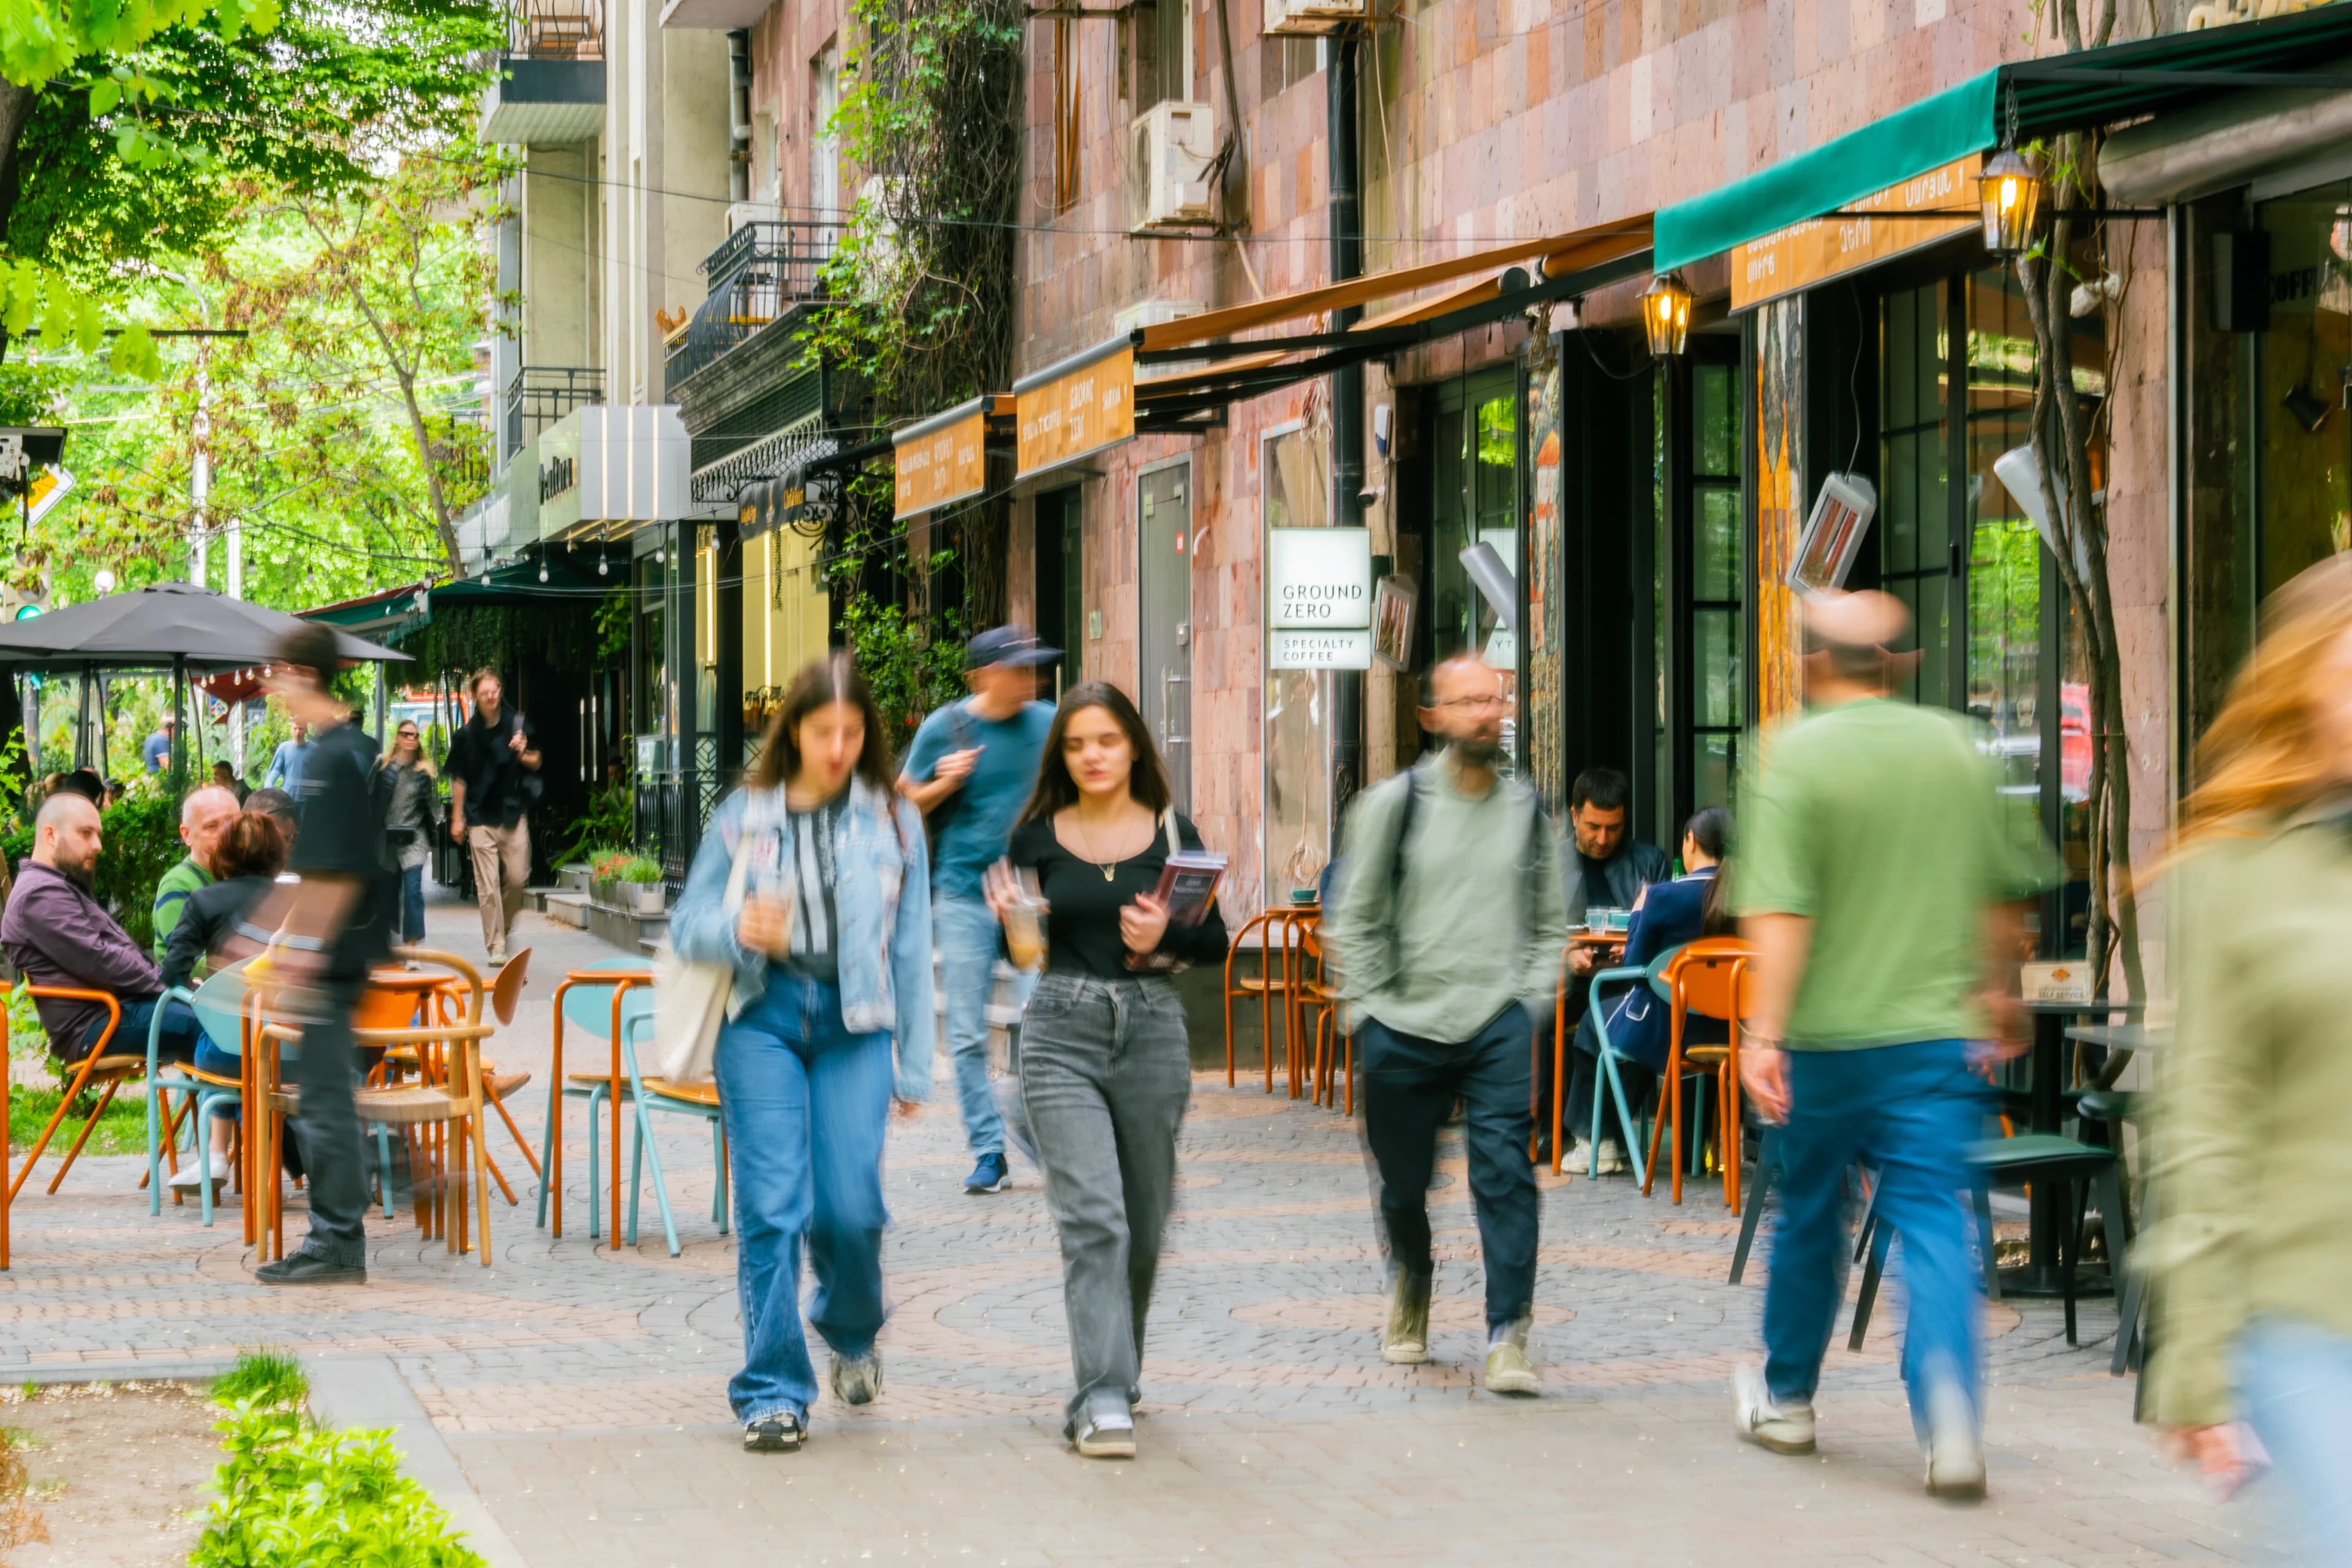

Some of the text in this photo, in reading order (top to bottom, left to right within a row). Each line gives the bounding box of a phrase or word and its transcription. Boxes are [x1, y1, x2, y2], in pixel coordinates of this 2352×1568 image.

[1283, 584, 1362, 600] GROUND
[1283, 603, 1332, 619] ZERO
[1284, 639, 1354, 649] SPECIALTY
[1283, 651, 1333, 662] COFFEE
[2038, 990, 2084, 999] SELF SERVICE
